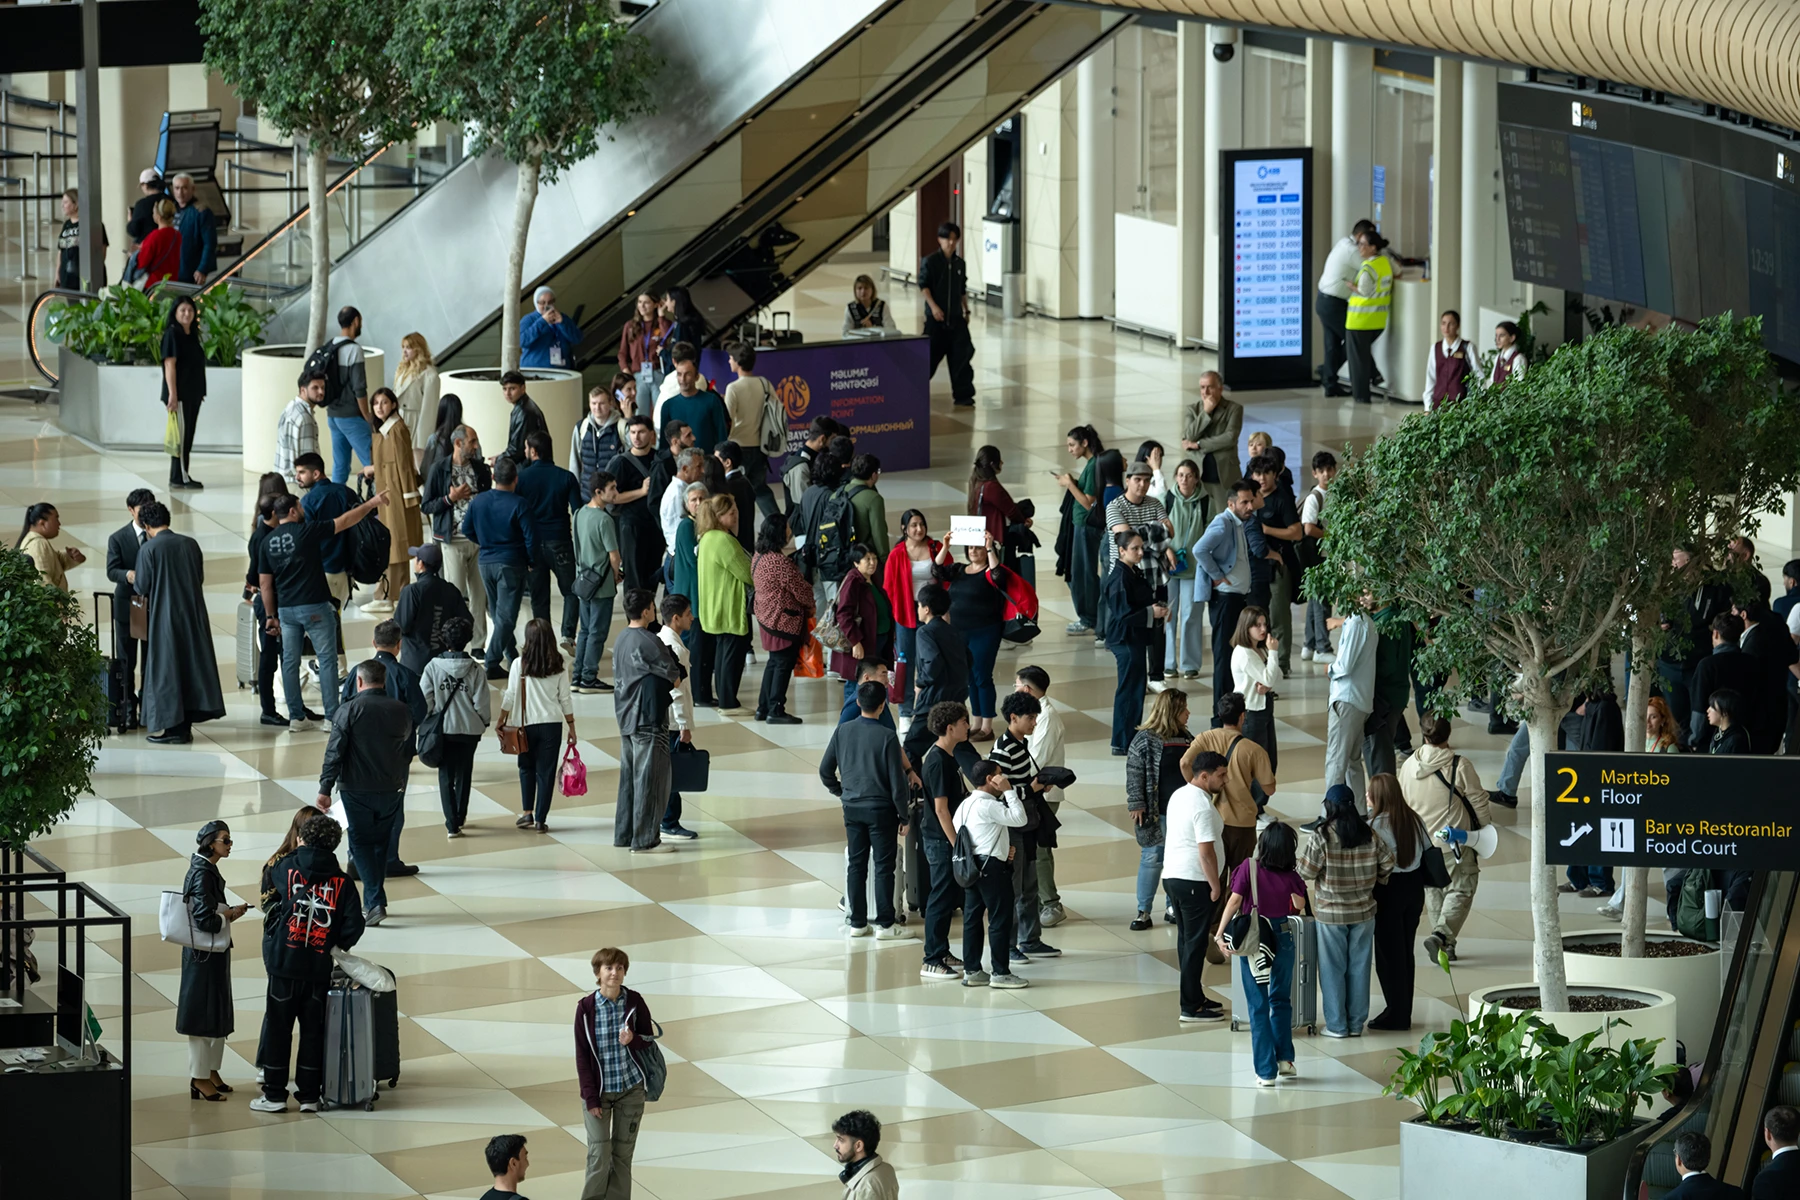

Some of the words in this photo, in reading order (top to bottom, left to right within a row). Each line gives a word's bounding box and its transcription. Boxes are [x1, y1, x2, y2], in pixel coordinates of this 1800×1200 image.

[1752, 248, 1774, 276] 12:39
[831, 395, 884, 407] INFORMATION
[831, 408, 854, 418] POINT
[849, 418, 914, 435] ОРМАЦИОННЫЙ
[1556, 767, 1591, 804] 2.
[1601, 770, 1670, 786] Mərtəbə
[1601, 789, 1642, 804] Floor
[1646, 820, 1672, 834] Bar
[1676, 823, 1695, 835] və
[1700, 820, 1792, 838] Restoranlar
[1646, 838, 1687, 854] Food
[1691, 840, 1737, 856] Court
